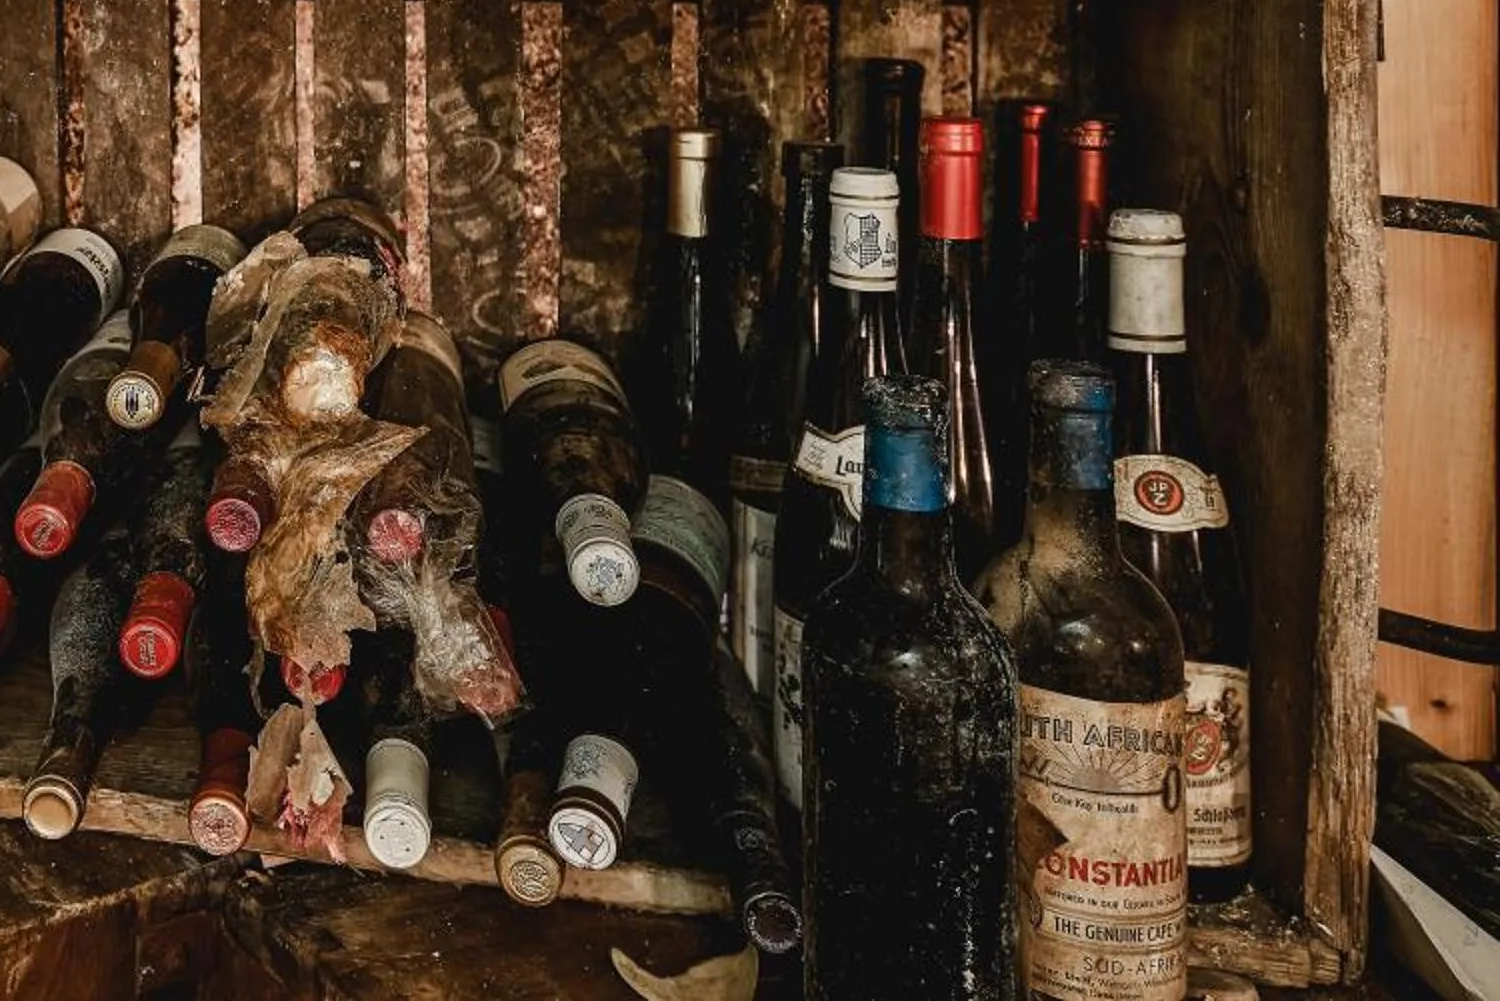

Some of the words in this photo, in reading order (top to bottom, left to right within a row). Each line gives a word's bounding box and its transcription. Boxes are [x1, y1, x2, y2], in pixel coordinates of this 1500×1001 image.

[1038, 852, 1183, 888] ONSTANTIA
[1054, 916, 1082, 938] THE
[1085, 924, 1144, 943] GENUINE
